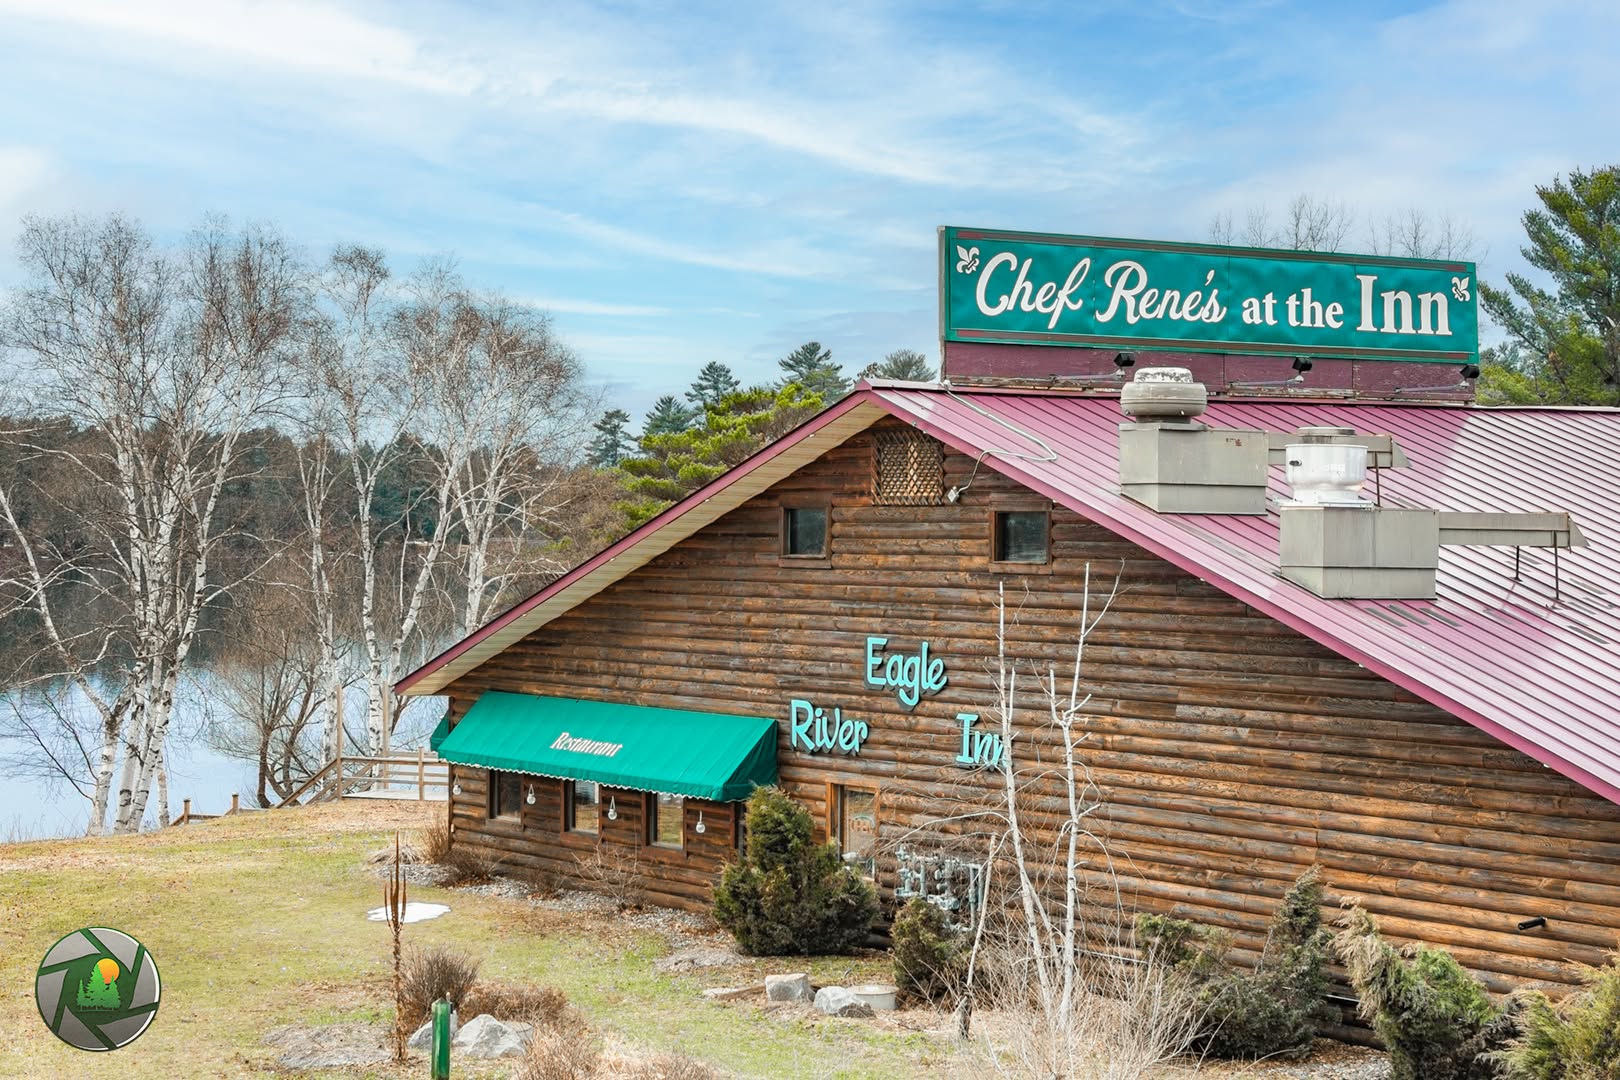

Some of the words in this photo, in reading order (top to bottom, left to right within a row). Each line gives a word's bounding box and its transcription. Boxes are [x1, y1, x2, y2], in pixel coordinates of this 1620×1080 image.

[976, 252, 1091, 329] Chef
[1095, 260, 1227, 324] Rene's
[1242, 292, 1277, 326] at
[1286, 288, 1344, 329] the
[1356, 274, 1453, 336] Inn
[866, 637, 948, 706] Eagle
[549, 732, 623, 757] Restaurant
[791, 700, 868, 752] River
